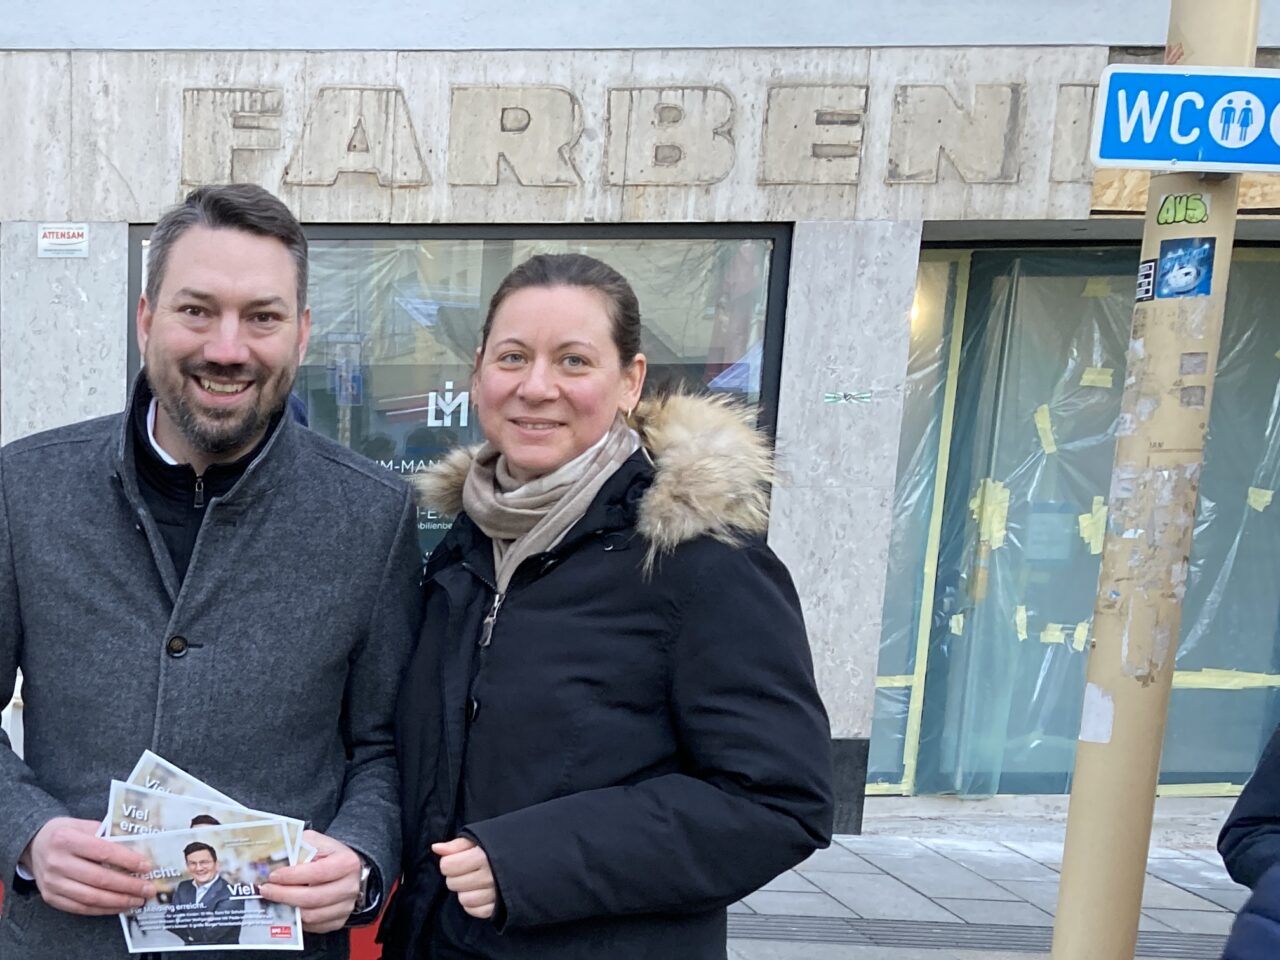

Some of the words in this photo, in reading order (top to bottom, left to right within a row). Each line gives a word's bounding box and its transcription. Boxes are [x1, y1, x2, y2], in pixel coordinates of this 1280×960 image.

[1118, 89, 1205, 145] WC
[42, 231, 84, 239] ATTENSAM
[122, 803, 149, 821] Viel
[226, 882, 255, 896] Viel
